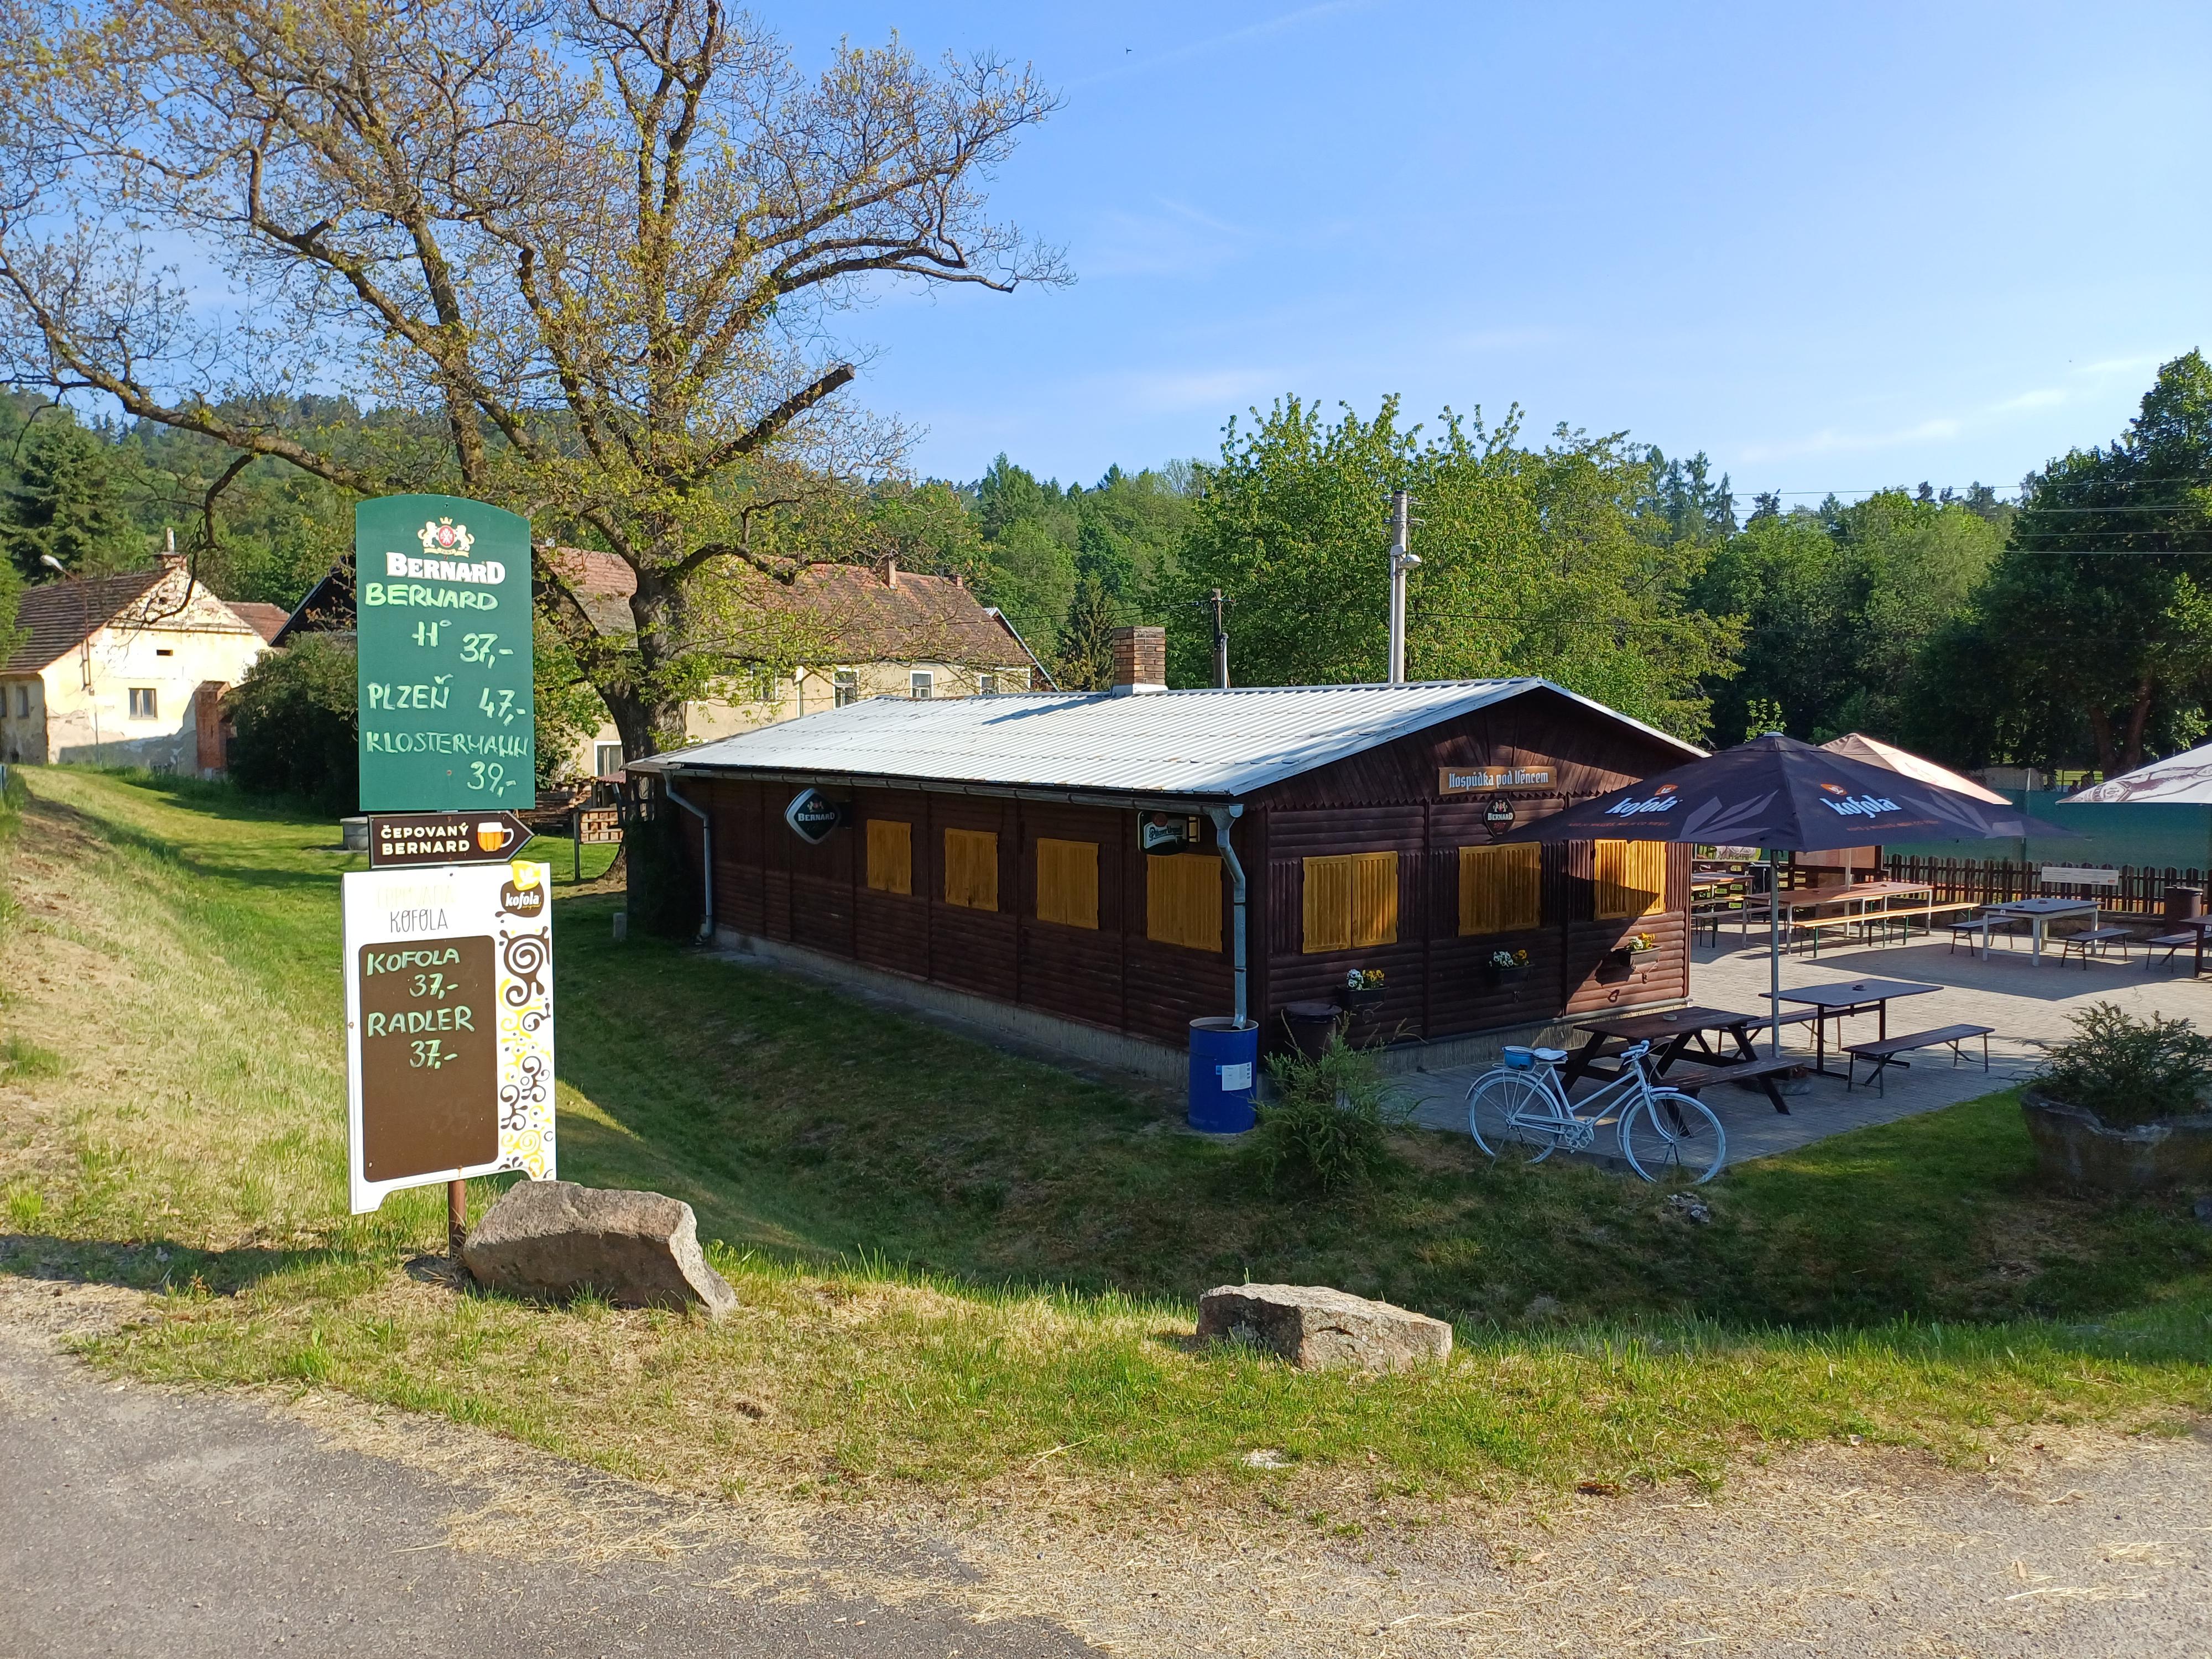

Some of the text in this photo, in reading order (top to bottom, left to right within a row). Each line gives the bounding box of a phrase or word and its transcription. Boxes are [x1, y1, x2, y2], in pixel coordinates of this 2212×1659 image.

[386, 552, 505, 585] BERNARD
[365, 582, 499, 611] BERNARD
[460, 633, 514, 669] 37,-
[367, 673, 525, 727] PLZEŇ 47,-
[366, 731, 529, 758] KLOSTERMANN
[467, 761, 517, 797] 39,-
[1448, 768, 1549, 791] Hospůdka pod Věncem
[798, 812, 835, 821] BERNARD
[1488, 812, 1514, 821] BERNARD
[1604, 796, 1678, 818] kofola
[1819, 795, 1902, 818] kofola
[380, 822, 469, 839] ČEPOVANÝ
[382, 840, 470, 855] BERNARD
[505, 891, 539, 910] kofola
[390, 909, 448, 933] KOFOLA
[367, 948, 461, 976] KOFOLA
[368, 1005, 476, 1037] RADLER
